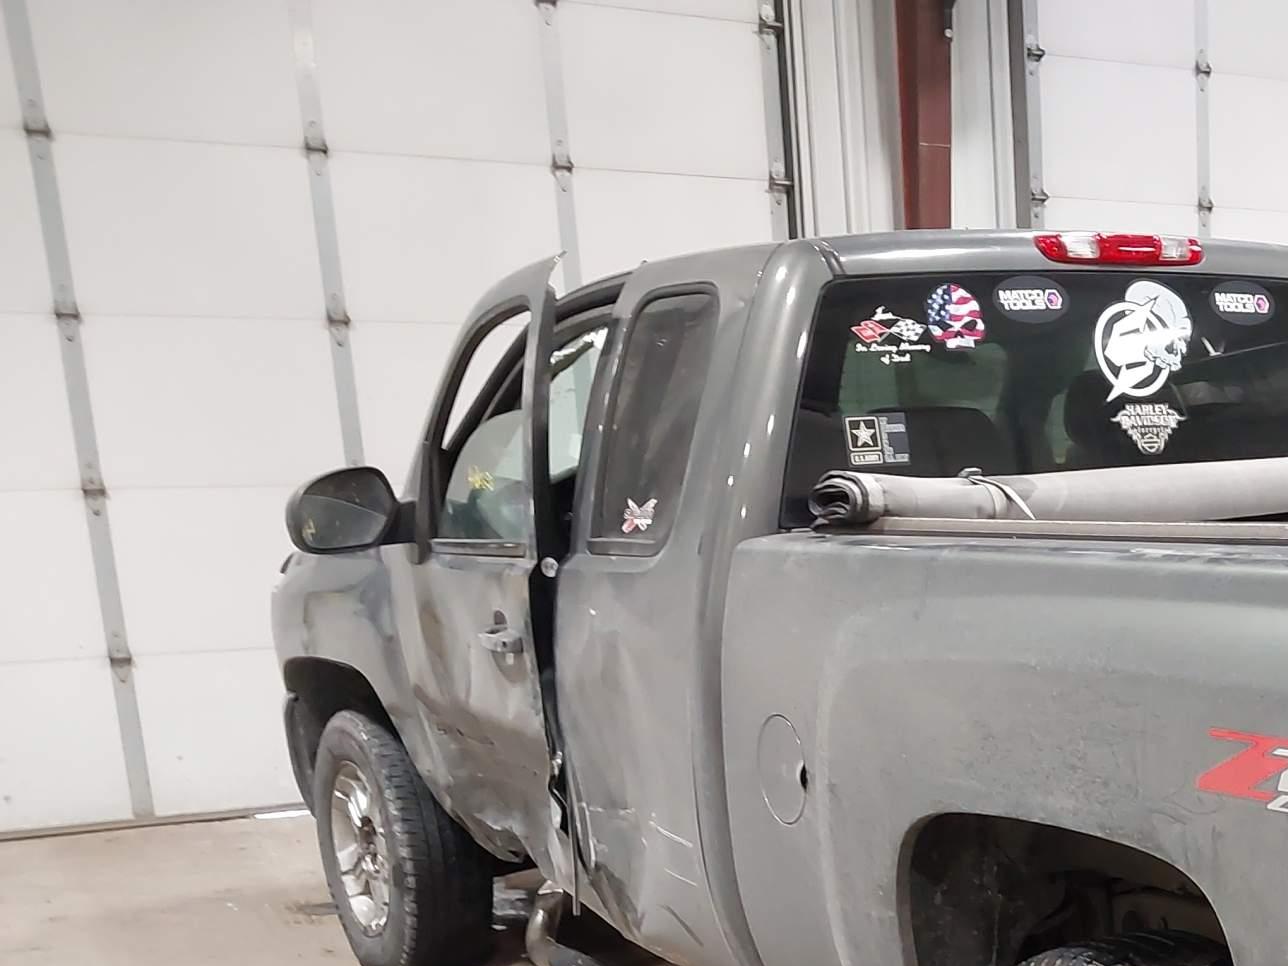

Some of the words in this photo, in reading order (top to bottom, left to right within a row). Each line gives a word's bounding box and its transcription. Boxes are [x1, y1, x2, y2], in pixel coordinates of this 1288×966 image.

[998, 289, 1044, 301] MATCO
[1215, 292, 1253, 304] MATCO
[1001, 299, 1046, 310] TOOLS
[1217, 301, 1255, 313] TOOLS
[1125, 403, 1169, 416] HARLEY
